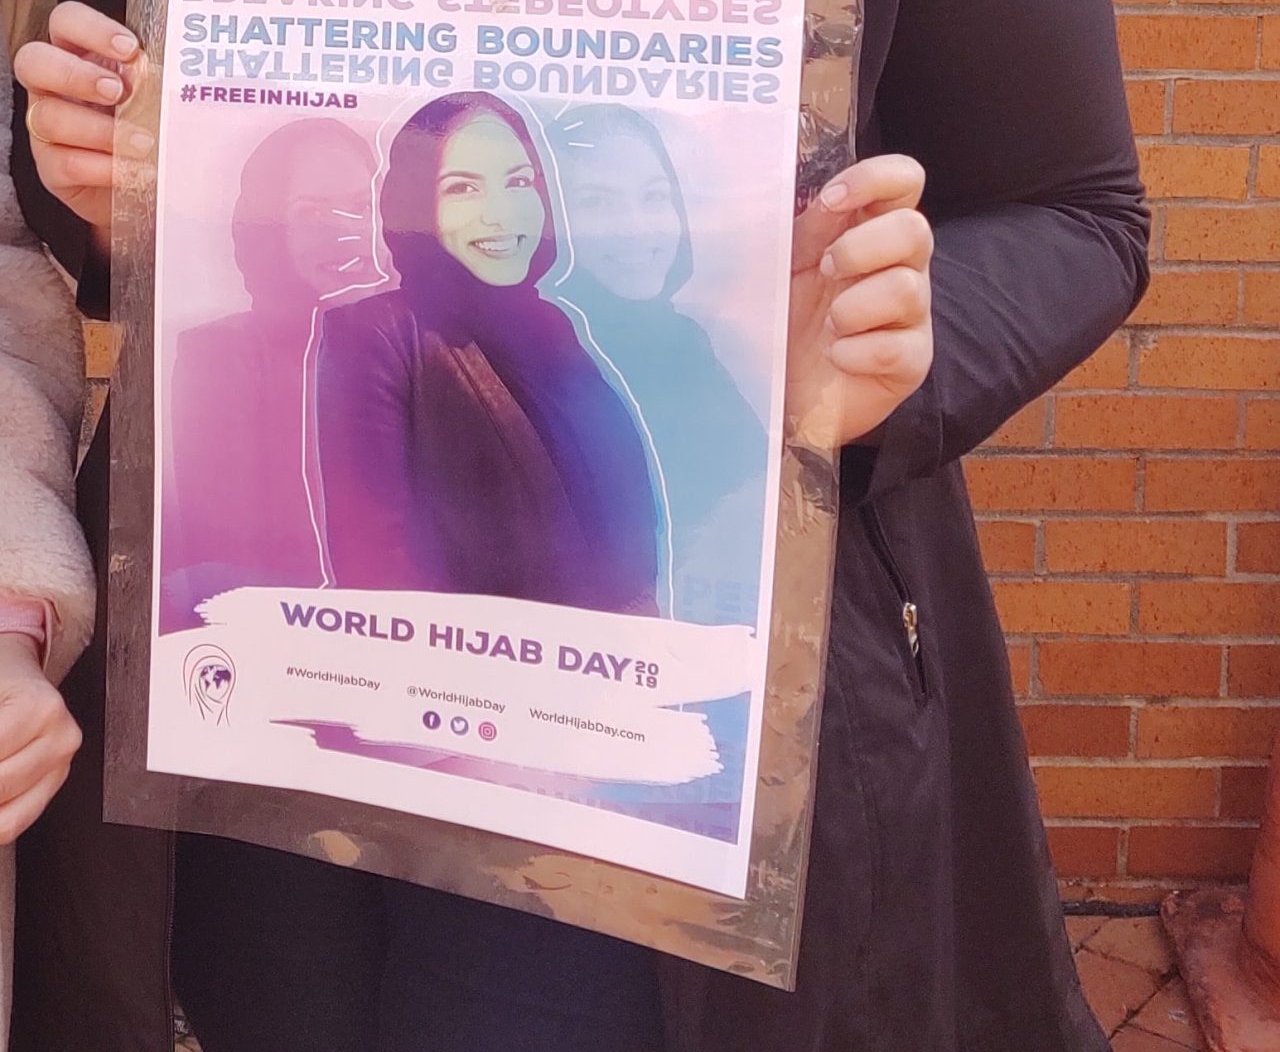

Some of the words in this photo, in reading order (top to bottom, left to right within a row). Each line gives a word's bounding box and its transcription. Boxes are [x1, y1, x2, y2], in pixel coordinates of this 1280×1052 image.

[182, 13, 457, 53] SHATTERING
[477, 25, 784, 69] BOUNDARIES
[280, 601, 415, 643] WORLD
[429, 623, 543, 665] HIJAB
[558, 645, 632, 682] DAY
[286, 666, 381, 691] #WorldHijabDay
[406, 685, 506, 714] @WorldHijabDay
[529, 707, 646, 743] WorldHijabDay.com
